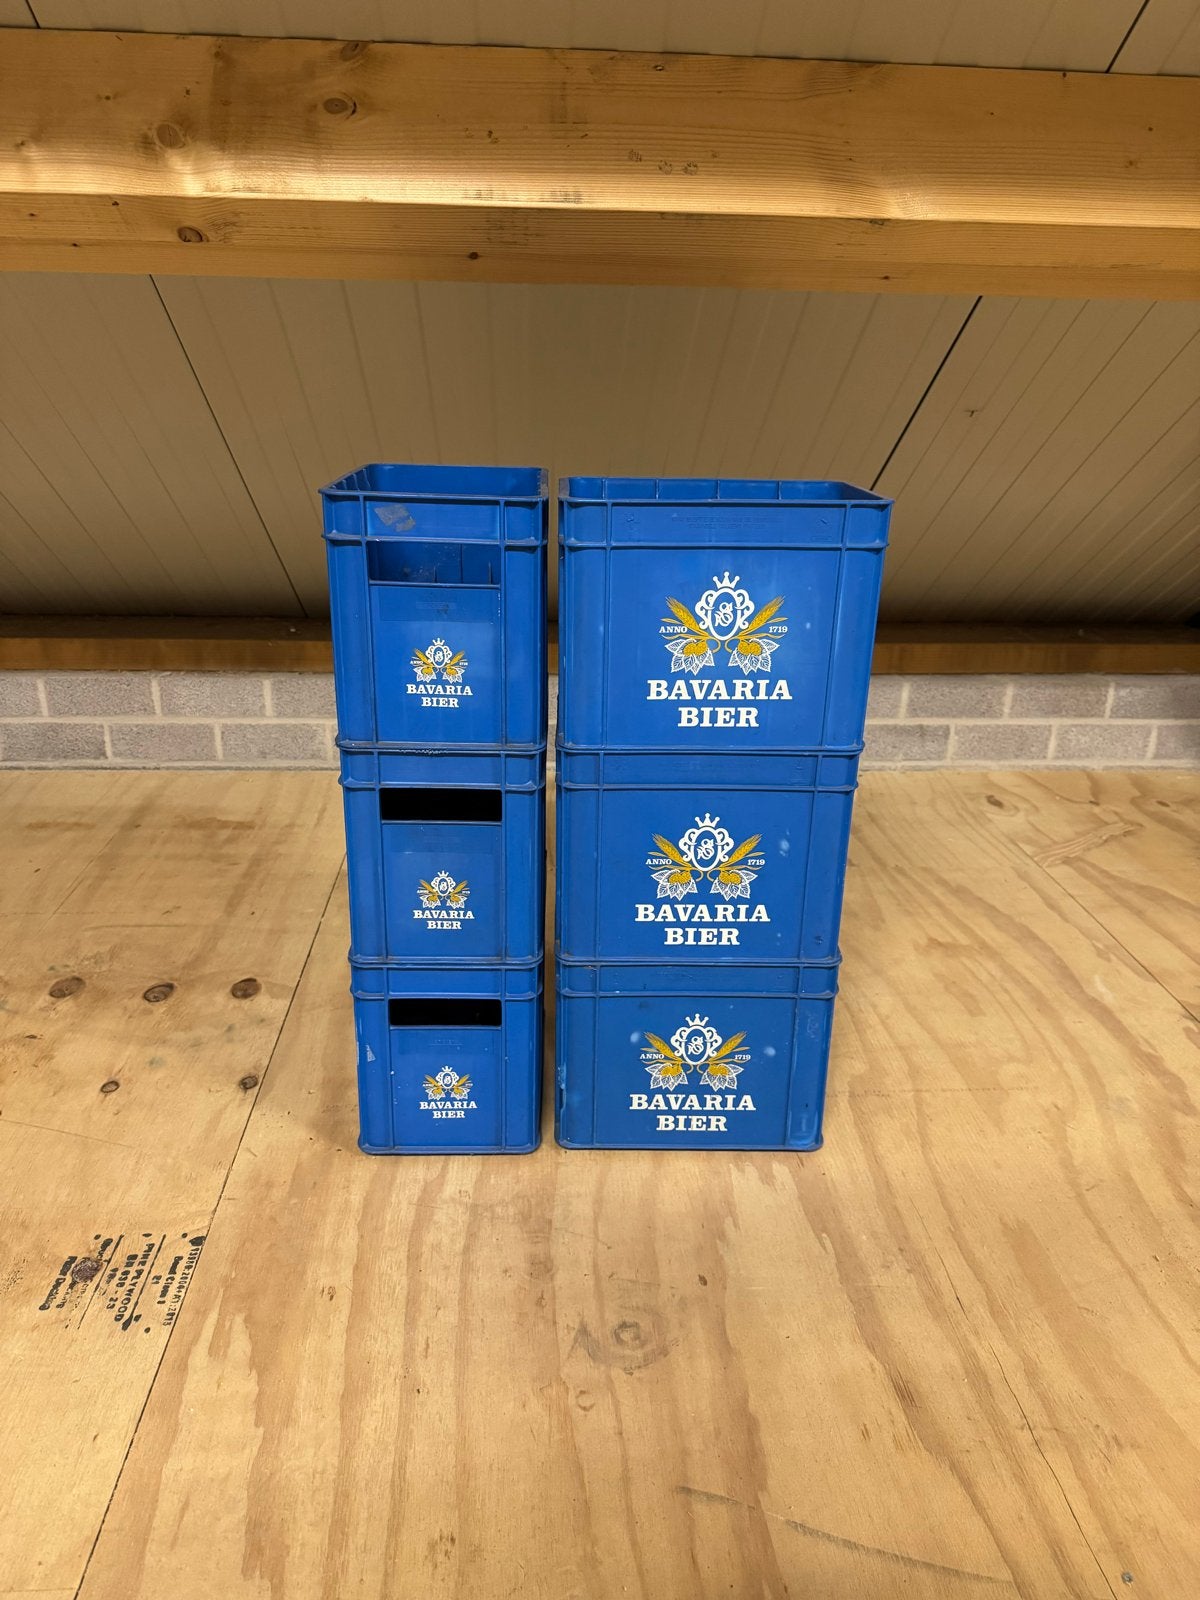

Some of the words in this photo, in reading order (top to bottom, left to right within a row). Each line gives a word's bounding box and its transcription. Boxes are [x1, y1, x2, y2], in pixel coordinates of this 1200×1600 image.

[407, 684, 473, 695] BAVARIA
[647, 680, 792, 700] BAVARIA
[422, 697, 459, 707] BIER
[678, 707, 759, 727] BIER
[413, 908, 474, 919] BAVARIA
[635, 904, 770, 922] BAVARIA
[427, 921, 462, 929] BIER
[664, 928, 740, 945] BIER
[420, 1101, 477, 1109] BAVARIA
[630, 1094, 756, 1110] BAVARIA
[656, 1115, 727, 1131] BIER
[115, 1269, 144, 1321] PLYWOOD
